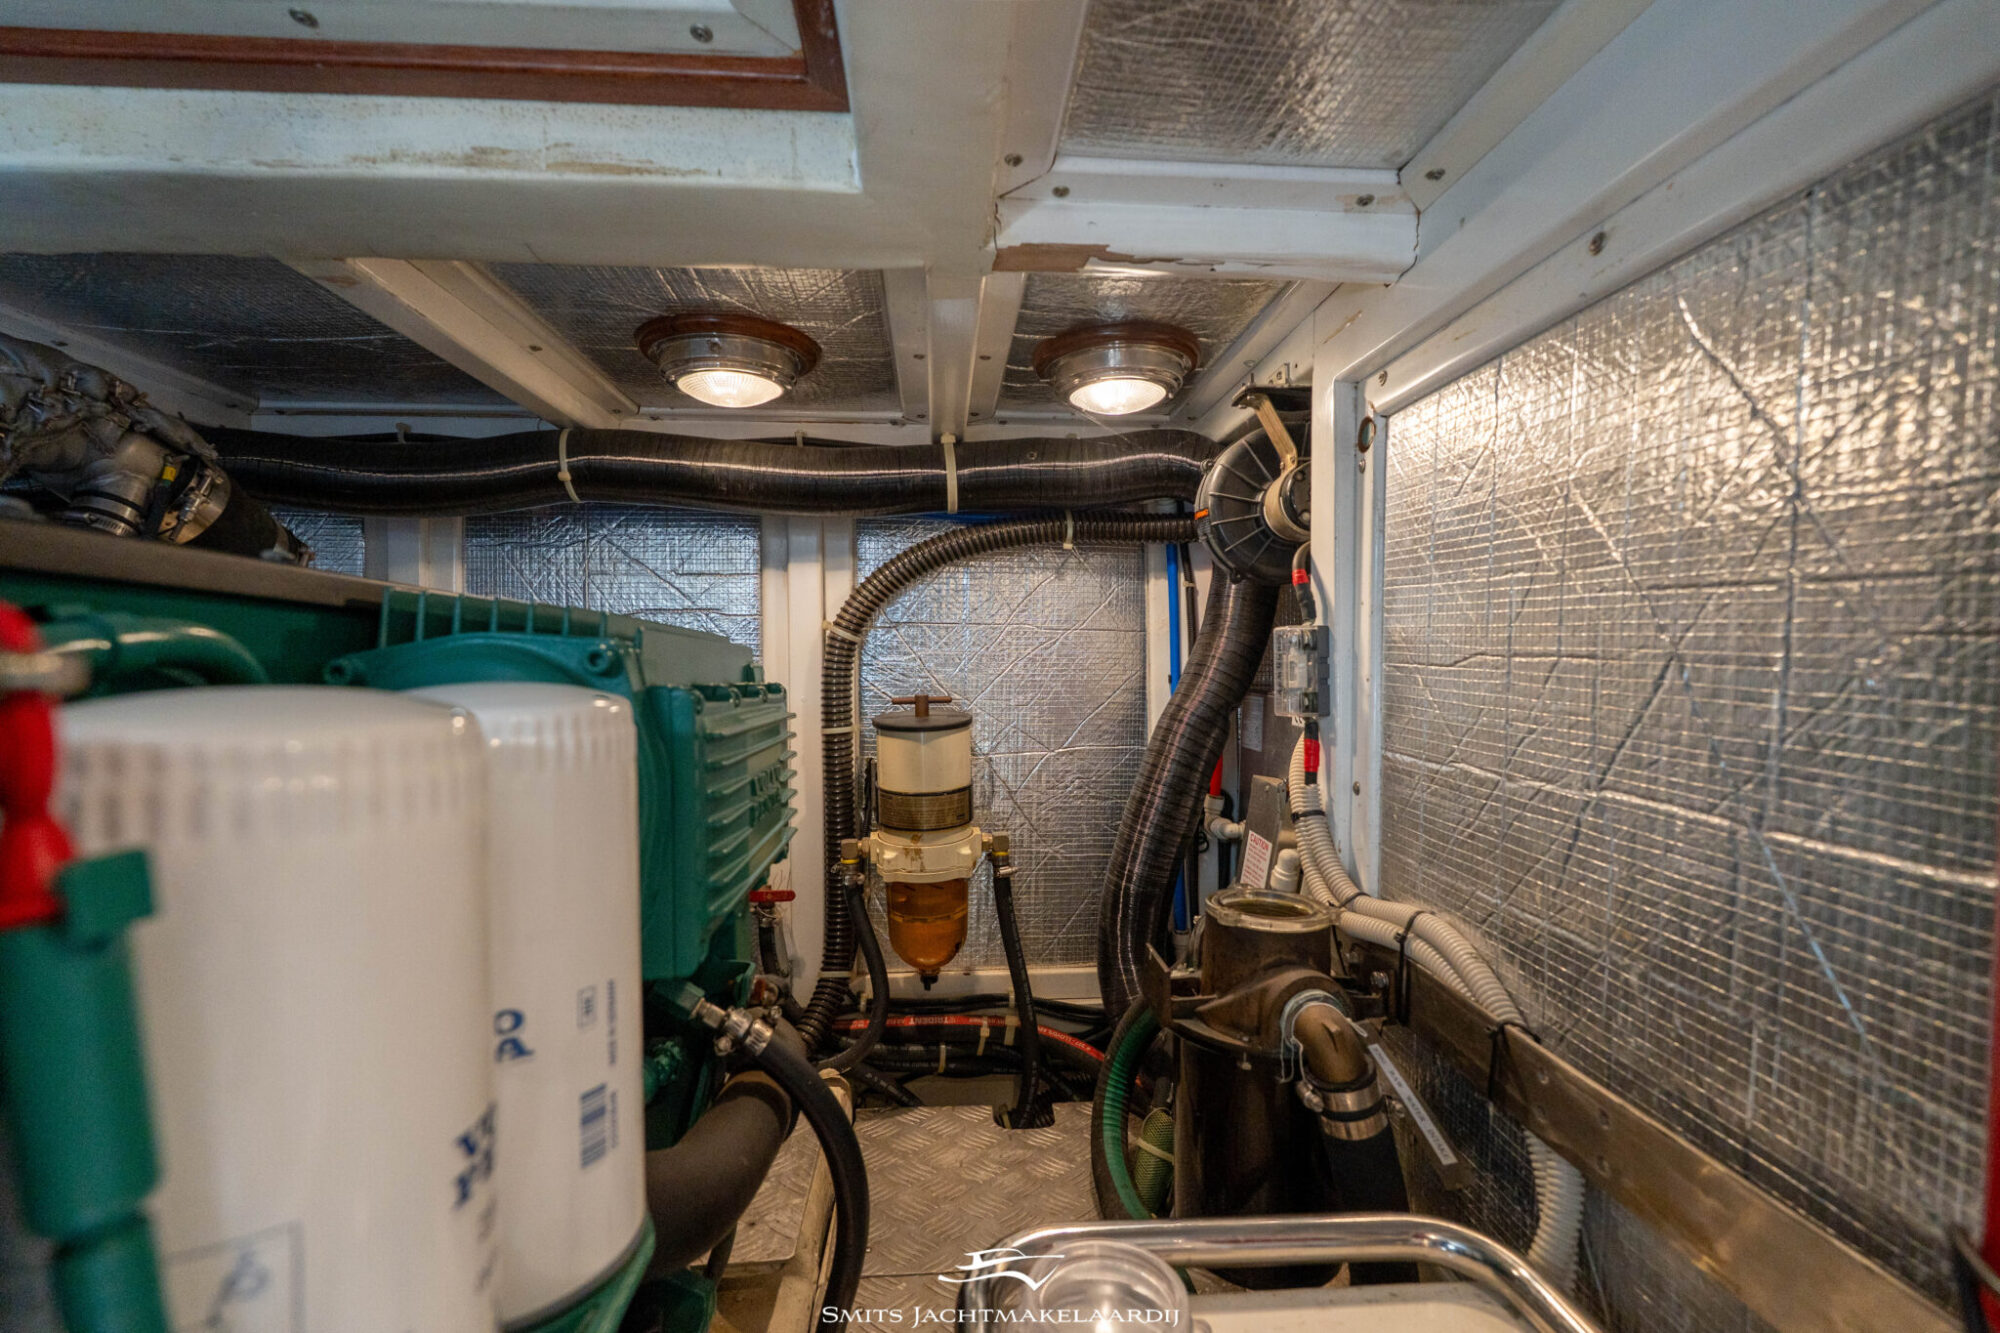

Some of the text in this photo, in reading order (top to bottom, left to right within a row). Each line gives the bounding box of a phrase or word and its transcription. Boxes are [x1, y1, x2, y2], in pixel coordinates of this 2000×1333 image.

[1250, 832, 1269, 851] CAUTION
[909, 1016, 949, 1025] TRIDENT
[1388, 1069, 1405, 1089] RAW
[1406, 1095, 1427, 1122] WATER
[1427, 1128, 1451, 1158] INTAKE
